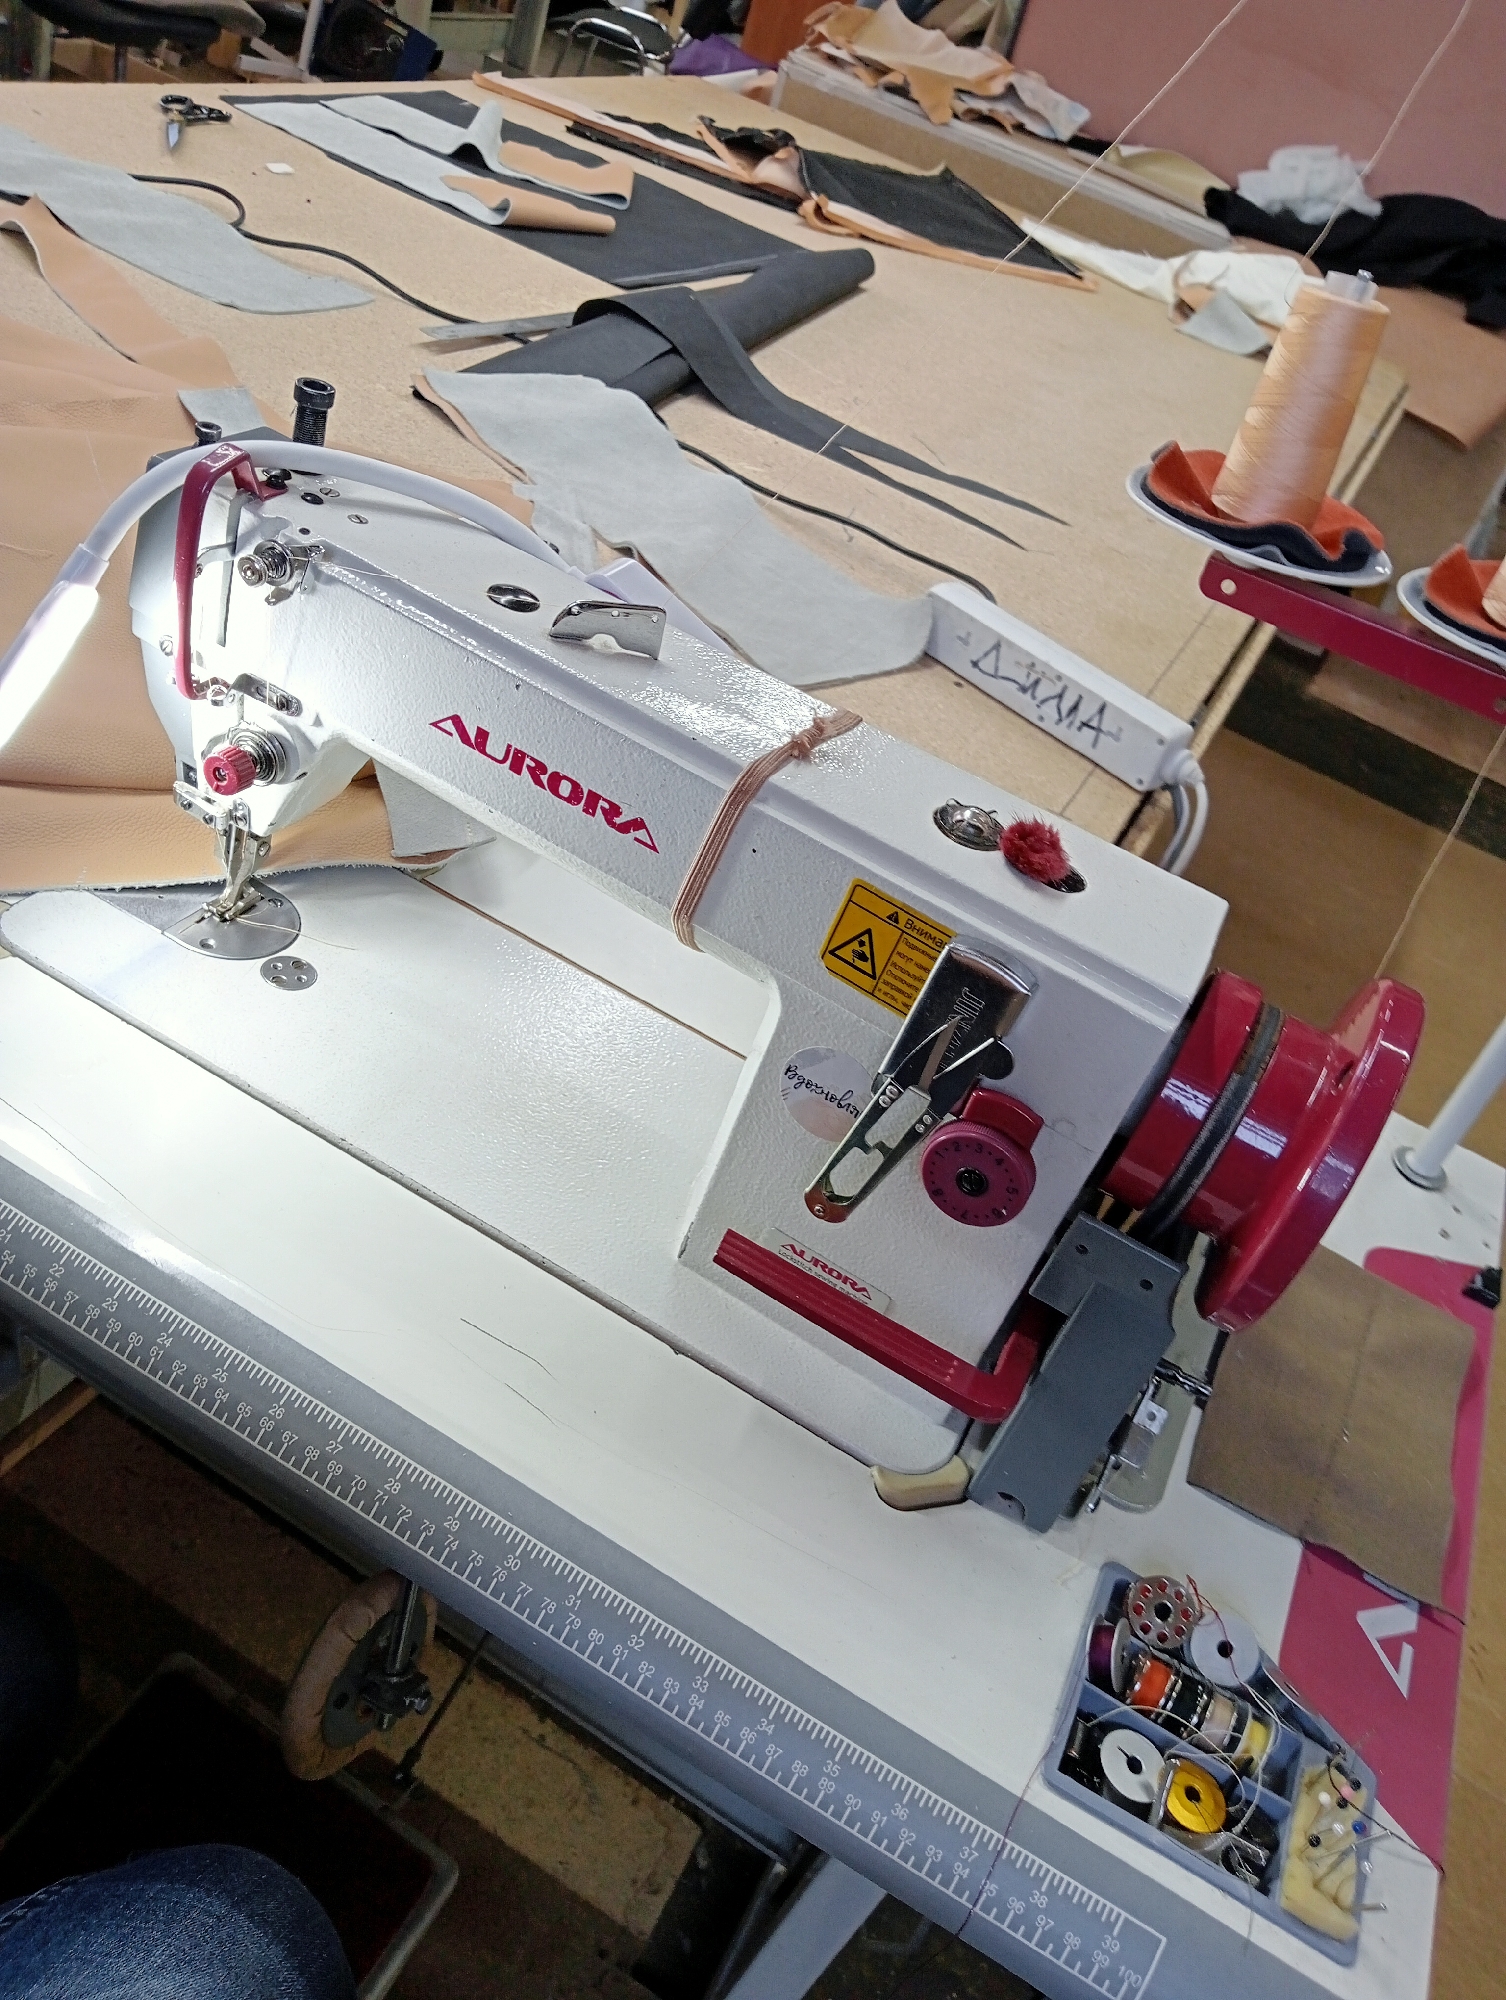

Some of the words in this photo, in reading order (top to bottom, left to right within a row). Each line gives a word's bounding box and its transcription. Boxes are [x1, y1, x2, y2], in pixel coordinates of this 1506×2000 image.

[428, 713, 660, 854] AURORA
[780, 1243, 872, 1301] AURORA
[1, 1250, 16, 1264] 54
[23, 1263, 38, 1278] 55
[44, 1277, 58, 1292] 56
[64, 1290, 80, 1304] 57
[85, 1304, 100, 1319] 58
[106, 1318, 121, 1332] 59
[128, 1332, 143, 1346] 60
[150, 1346, 164, 1360] 61
[172, 1360, 187, 1375] 62
[193, 1374, 208, 1389] 63
[214, 1388, 230, 1403] 64
[237, 1402, 253, 1417] 65
[259, 1416, 275, 1431] 66
[282, 1431, 299, 1445] 67
[304, 1445, 320, 1461] 68
[327, 1460, 343, 1475] 69
[351, 1474, 367, 1491] 70
[374, 1489, 389, 1506] 71
[397, 1504, 413, 1522] 72
[420, 1519, 435, 1536] 73
[444, 1534, 459, 1551] 74
[468, 1550, 484, 1567] 75
[492, 1565, 508, 1582] 76
[516, 1581, 533, 1597] 77
[541, 1597, 557, 1614] 78
[565, 1612, 581, 1630] 79
[588, 1628, 604, 1645] 80
[612, 1644, 629, 1660] 81
[638, 1661, 655, 1678] 82
[663, 1677, 680, 1694] 83
[688, 1694, 705, 1710] 84
[714, 1710, 732, 1727] 85
[740, 1727, 757, 1744] 86
[765, 1744, 783, 1759] 87
[791, 1760, 809, 1777] 88
[818, 1777, 835, 1793] 89
[844, 1794, 861, 1810] 90
[871, 1810, 887, 1827] 91
[899, 1828, 916, 1846] 92
[925, 1845, 943, 1862] 93
[953, 1862, 970, 1879] 94
[1007, 1896, 1026, 1915] 96
[1035, 1915, 1054, 1930] 97
[1062, 1931, 1081, 1950] 98
[1091, 1950, 1110, 1968] 99
[1118, 1965, 1142, 1988] 100
[49, 1263, 65, 1278] 22
[101, 1297, 118, 1312] 23
[156, 1332, 173, 1348] 24
[211, 1368, 229, 1383] 25
[268, 1403, 285, 1419] 26
[325, 1440, 343, 1455] 27
[384, 1478, 401, 1494] 28
[443, 1516, 460, 1532] 29
[504, 1554, 521, 1571] 30
[565, 1594, 581, 1611] 31
[627, 1634, 645, 1652] 32
[692, 1676, 709, 1693] 33
[757, 1718, 775, 1735] 34
[823, 1760, 841, 1777] 35
[891, 1803, 909, 1820] 36
[959, 1846, 979, 1862] 37
[1029, 1890, 1048, 1908] 38
[1101, 1935, 1120, 1952] 39
